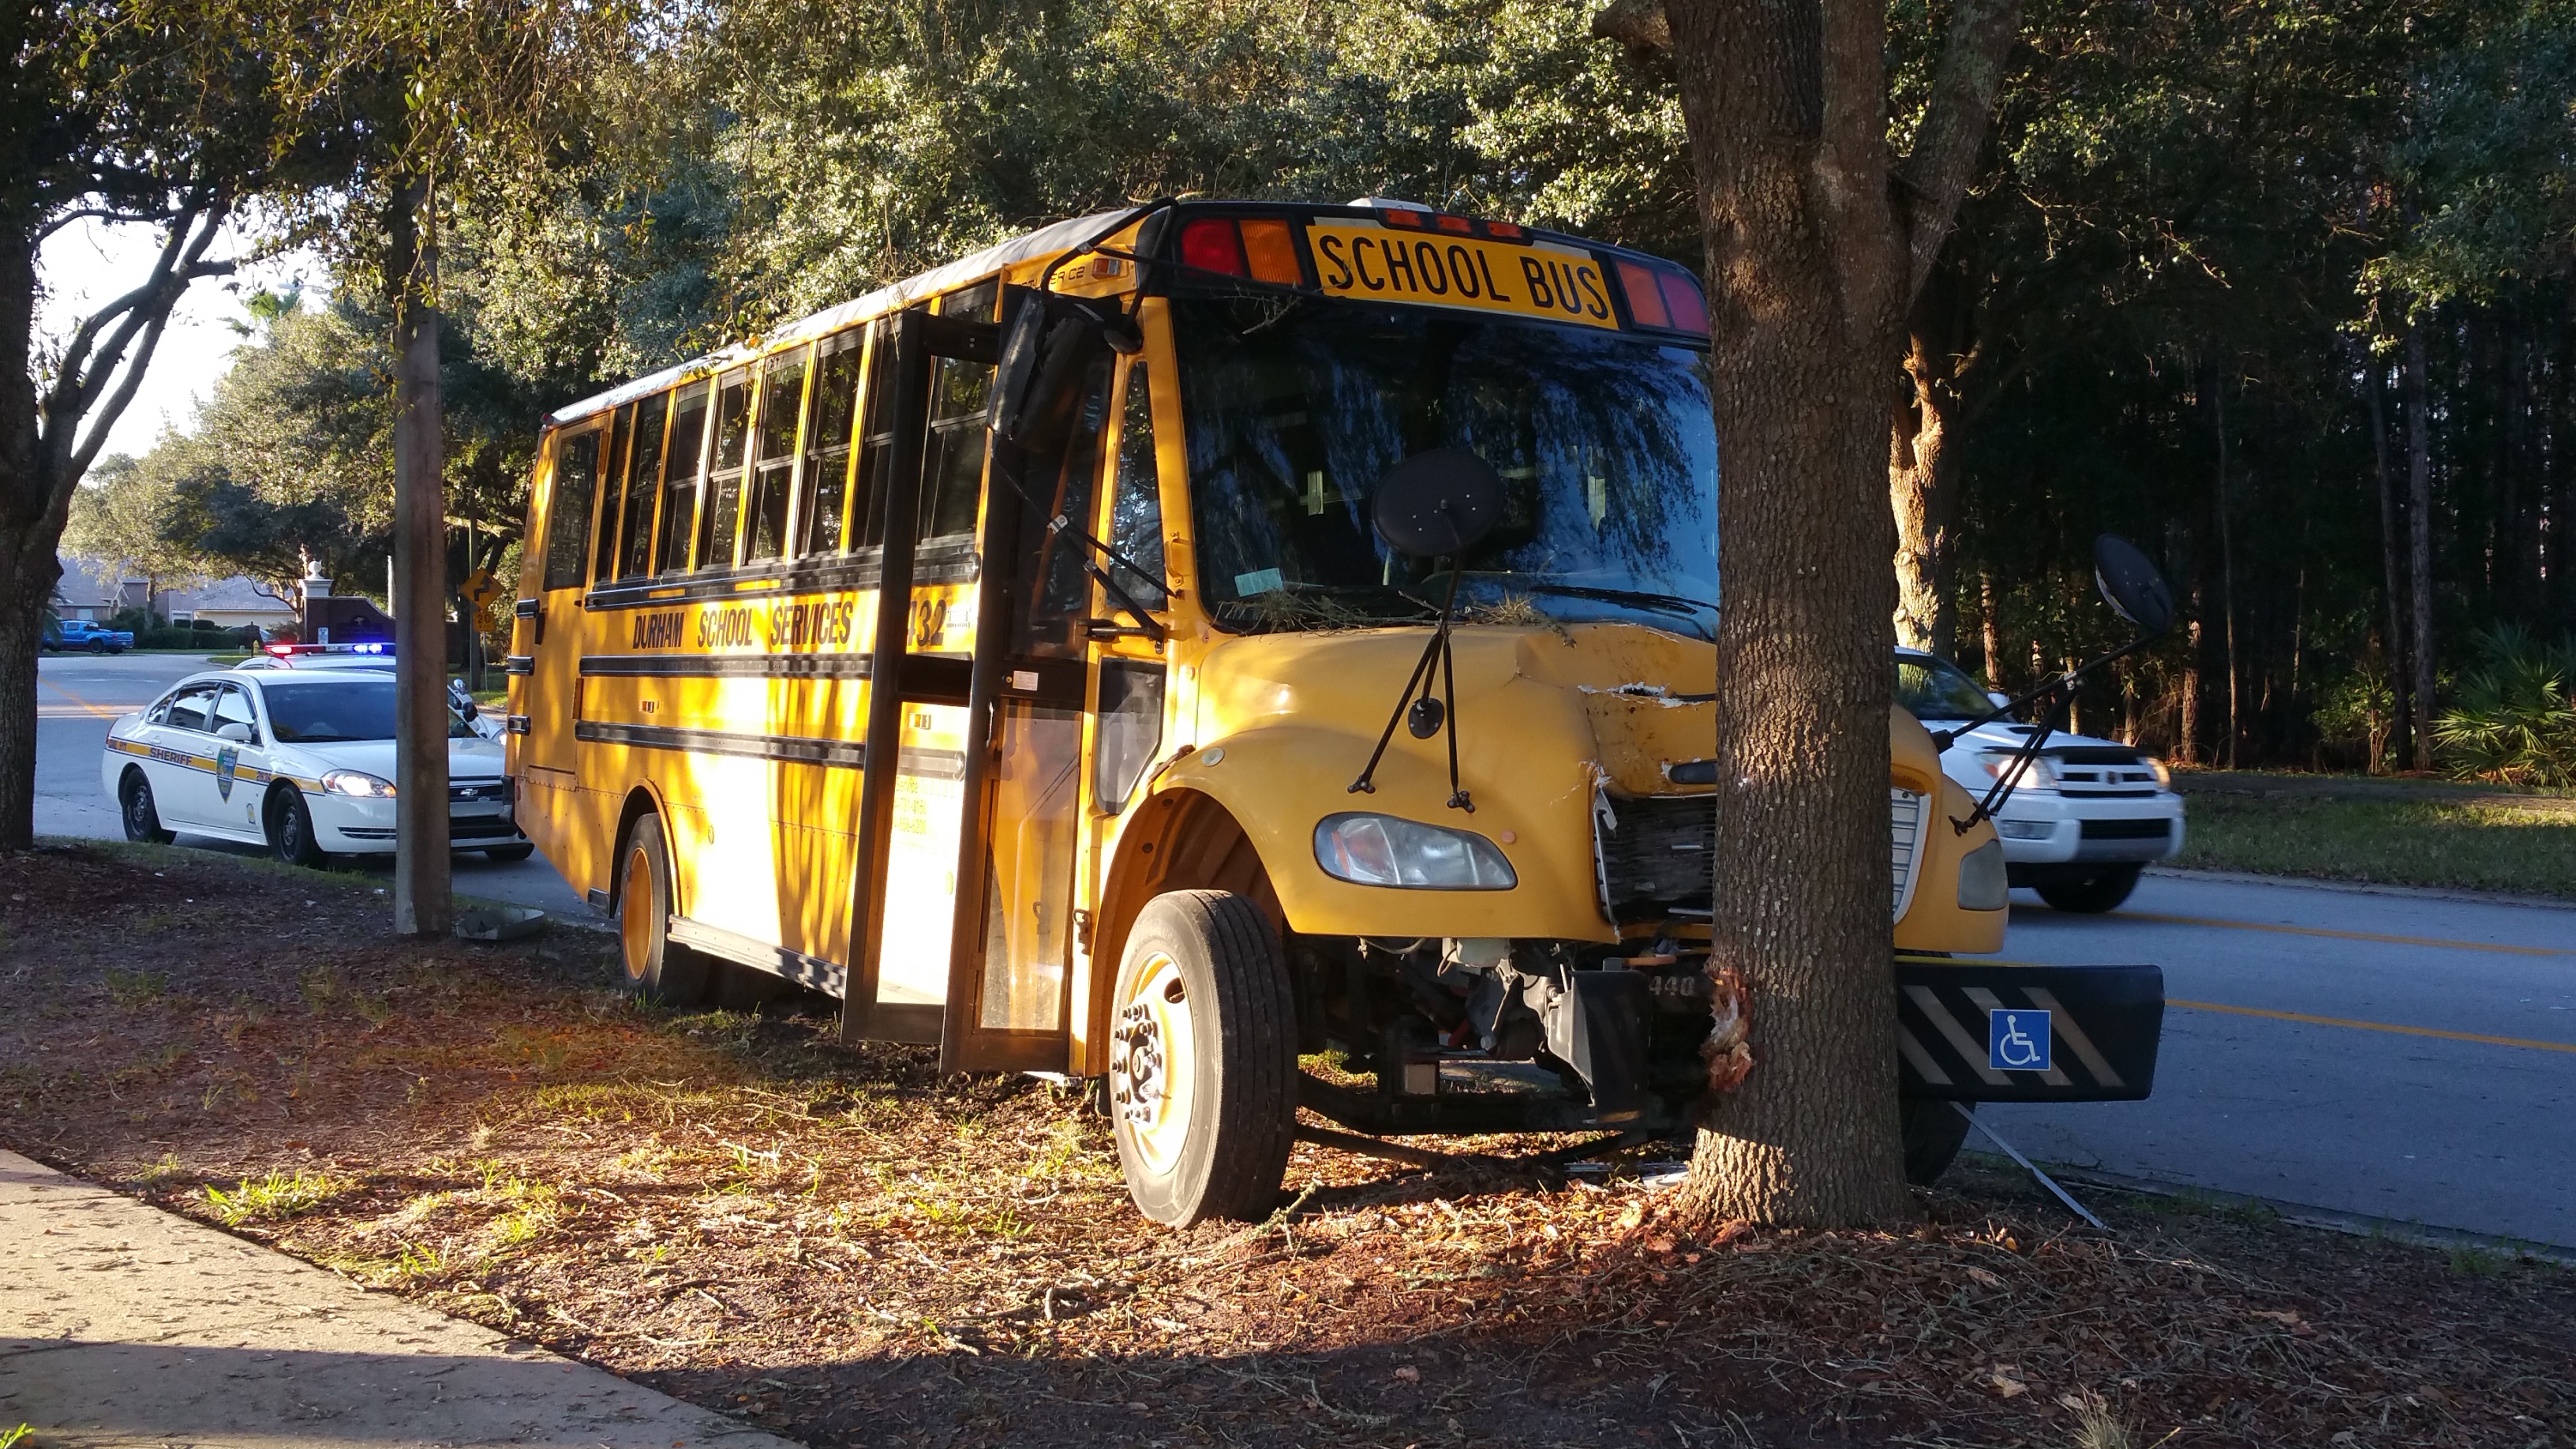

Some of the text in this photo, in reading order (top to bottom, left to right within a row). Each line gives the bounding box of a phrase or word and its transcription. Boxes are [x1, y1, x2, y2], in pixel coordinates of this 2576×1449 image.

[1069, 266, 1085, 282] C2
[1319, 234, 1609, 320] SCHOOL BUS
[477, 614, 491, 624] 20
[632, 600, 853, 650] DURHAM SCHOOL SERVICES
[150, 747, 193, 766] SHERIFF
[1649, 975, 1695, 998] 440
